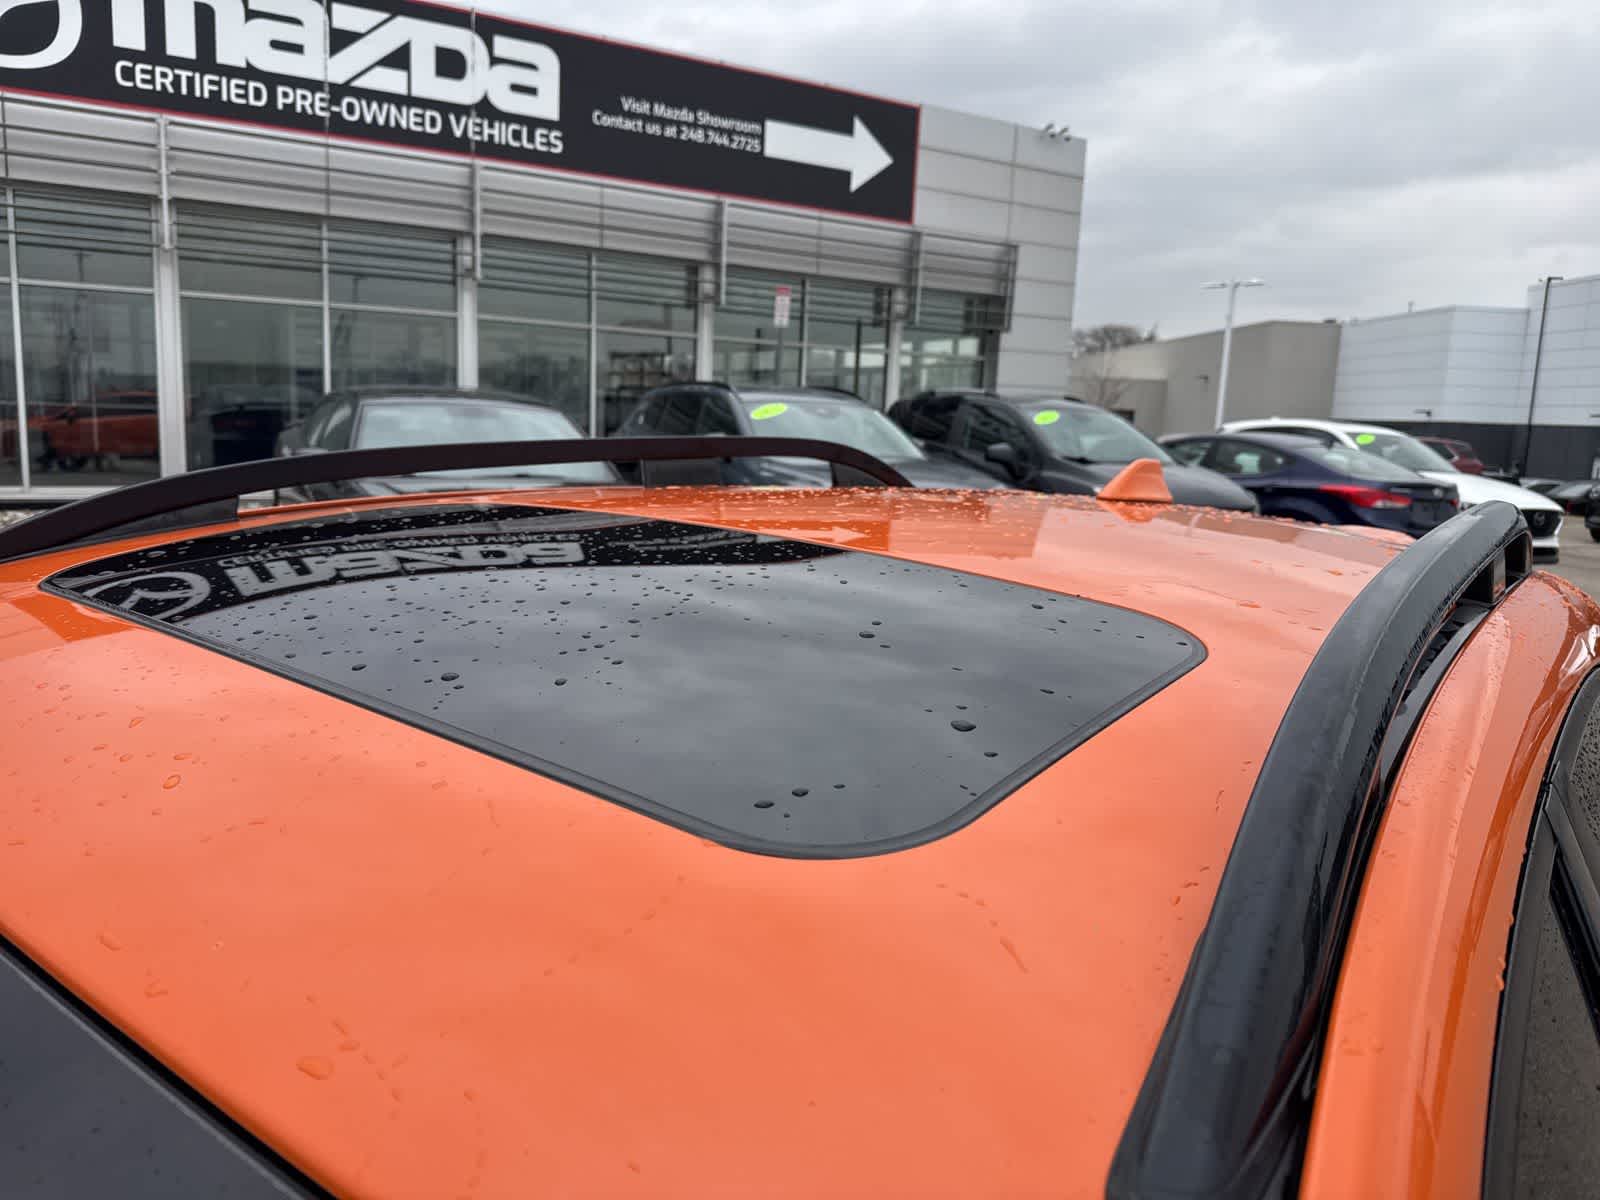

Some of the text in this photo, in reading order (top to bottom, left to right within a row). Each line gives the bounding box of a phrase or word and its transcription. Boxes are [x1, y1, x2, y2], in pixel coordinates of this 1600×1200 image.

[115, 60, 563, 154] CERTIFIED PRE-OWNED VEHICLES
[620, 95, 762, 135] Visit Mazda Showroom
[592, 109, 761, 153] Contact us at 248.744.2725
